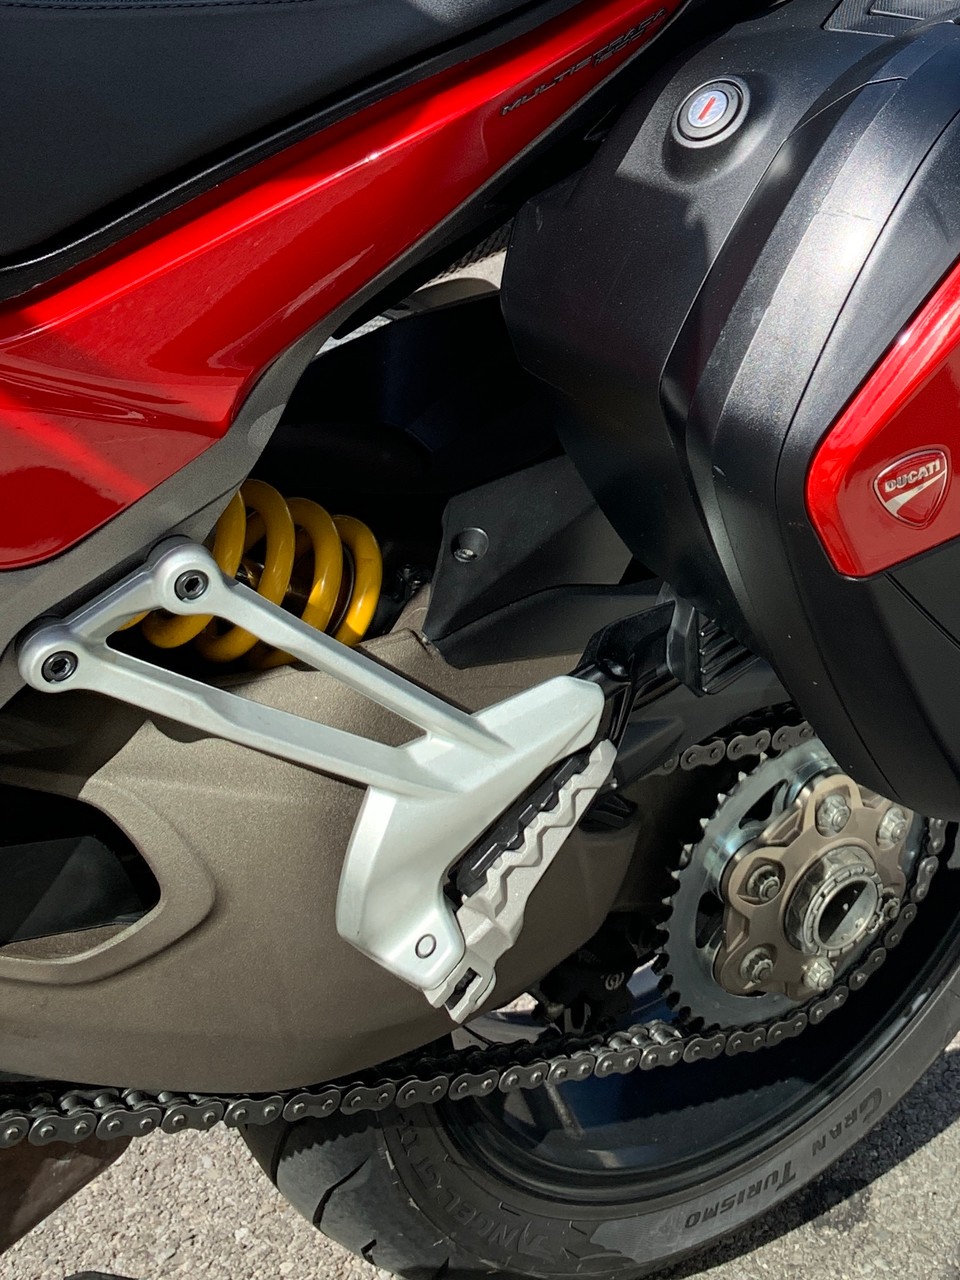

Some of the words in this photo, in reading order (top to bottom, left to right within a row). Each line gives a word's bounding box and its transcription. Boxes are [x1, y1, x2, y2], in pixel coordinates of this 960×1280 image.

[885, 458, 941, 493] DUCATI
[811, 1087, 883, 1157] GRAN
[684, 1160, 797, 1229] TURISMO
